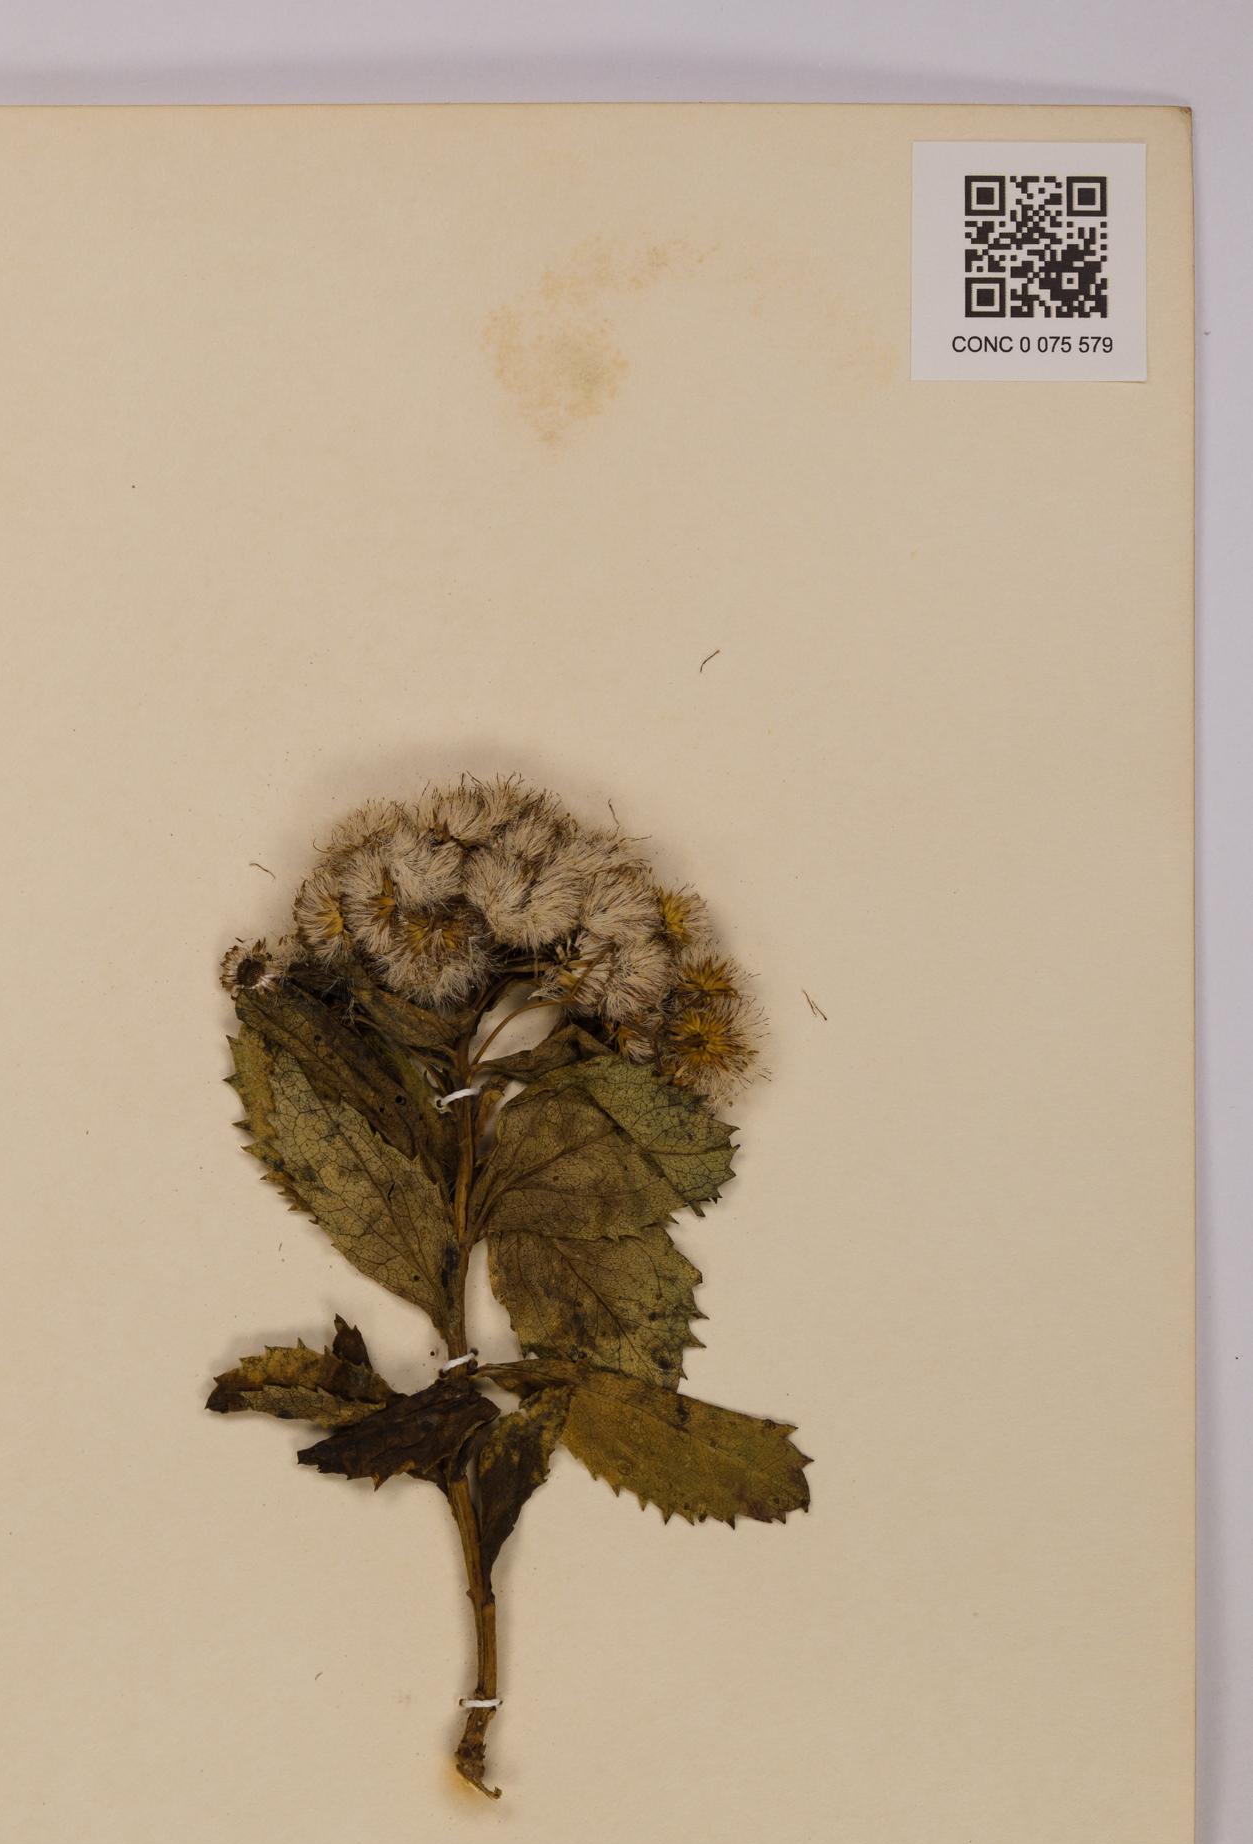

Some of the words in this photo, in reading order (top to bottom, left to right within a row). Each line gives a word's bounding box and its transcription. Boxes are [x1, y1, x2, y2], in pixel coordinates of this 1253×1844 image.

[952, 336, 1013, 352] CONC
[1020, 337, 1030, 352] 0
[1038, 336, 1071, 353] 075
[1079, 337, 1112, 353] 579
